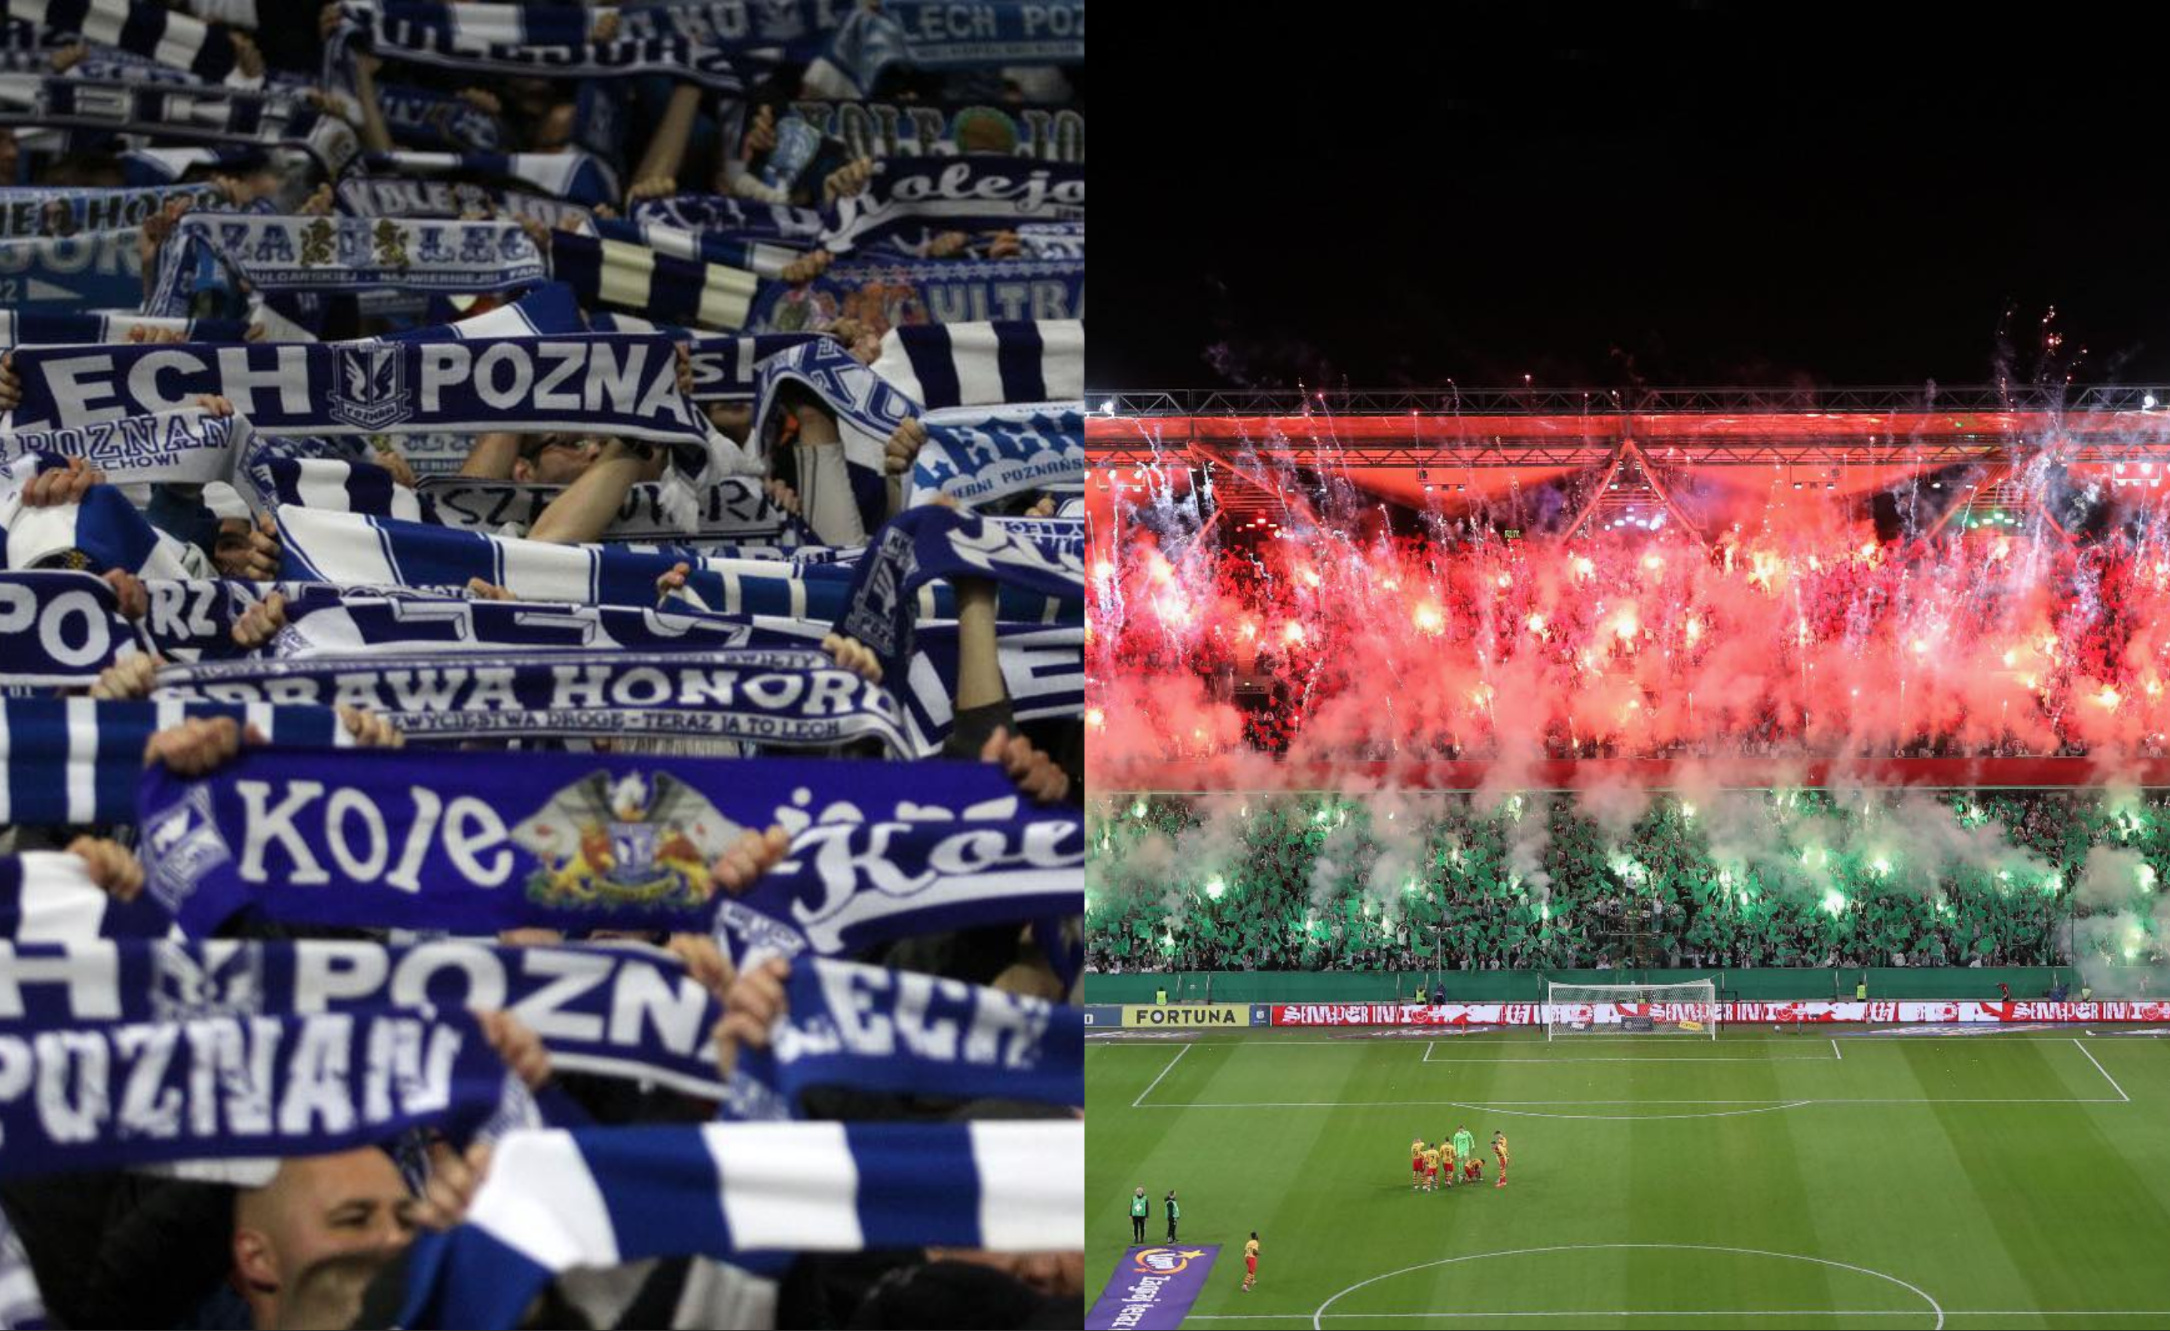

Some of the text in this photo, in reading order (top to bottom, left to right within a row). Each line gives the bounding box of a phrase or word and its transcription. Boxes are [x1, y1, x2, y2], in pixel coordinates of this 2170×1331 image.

[926, 278, 1085, 323] ULTR
[419, 340, 692, 424] POZNA
[90, 452, 181, 471] ECHOWI
[643, 712, 713, 731] TERAZ
[749, 718, 775, 734] TO
[781, 720, 840, 736] LECH
[236, 780, 513, 893] Kole
[294, 936, 718, 1062] POZN
[1136, 1009, 1236, 1024] FORTUNA
